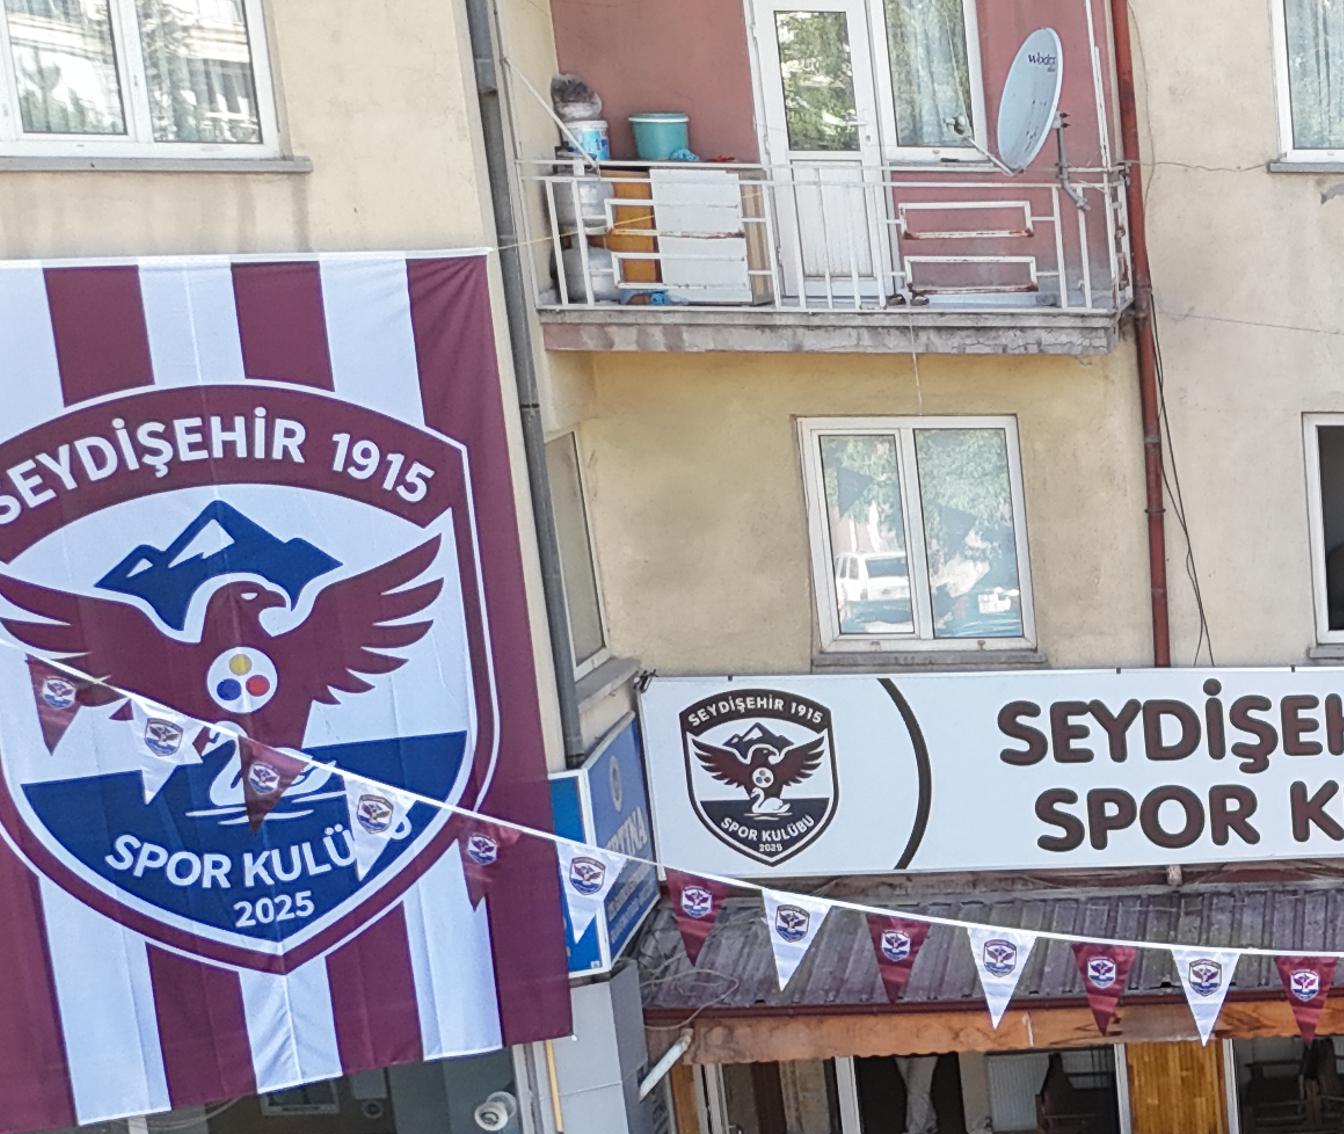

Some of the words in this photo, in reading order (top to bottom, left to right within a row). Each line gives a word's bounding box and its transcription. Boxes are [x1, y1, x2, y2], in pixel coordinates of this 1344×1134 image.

[331, 432, 436, 503] 1915
[687, 694, 785, 727] SEYDİŞEHİR
[790, 702, 824, 724] 1915
[720, 816, 758, 842] SPOR
[1035, 784, 1261, 852] SPOR
[104, 833, 232, 889] SPOR
[233, 890, 316, 928] 2025
